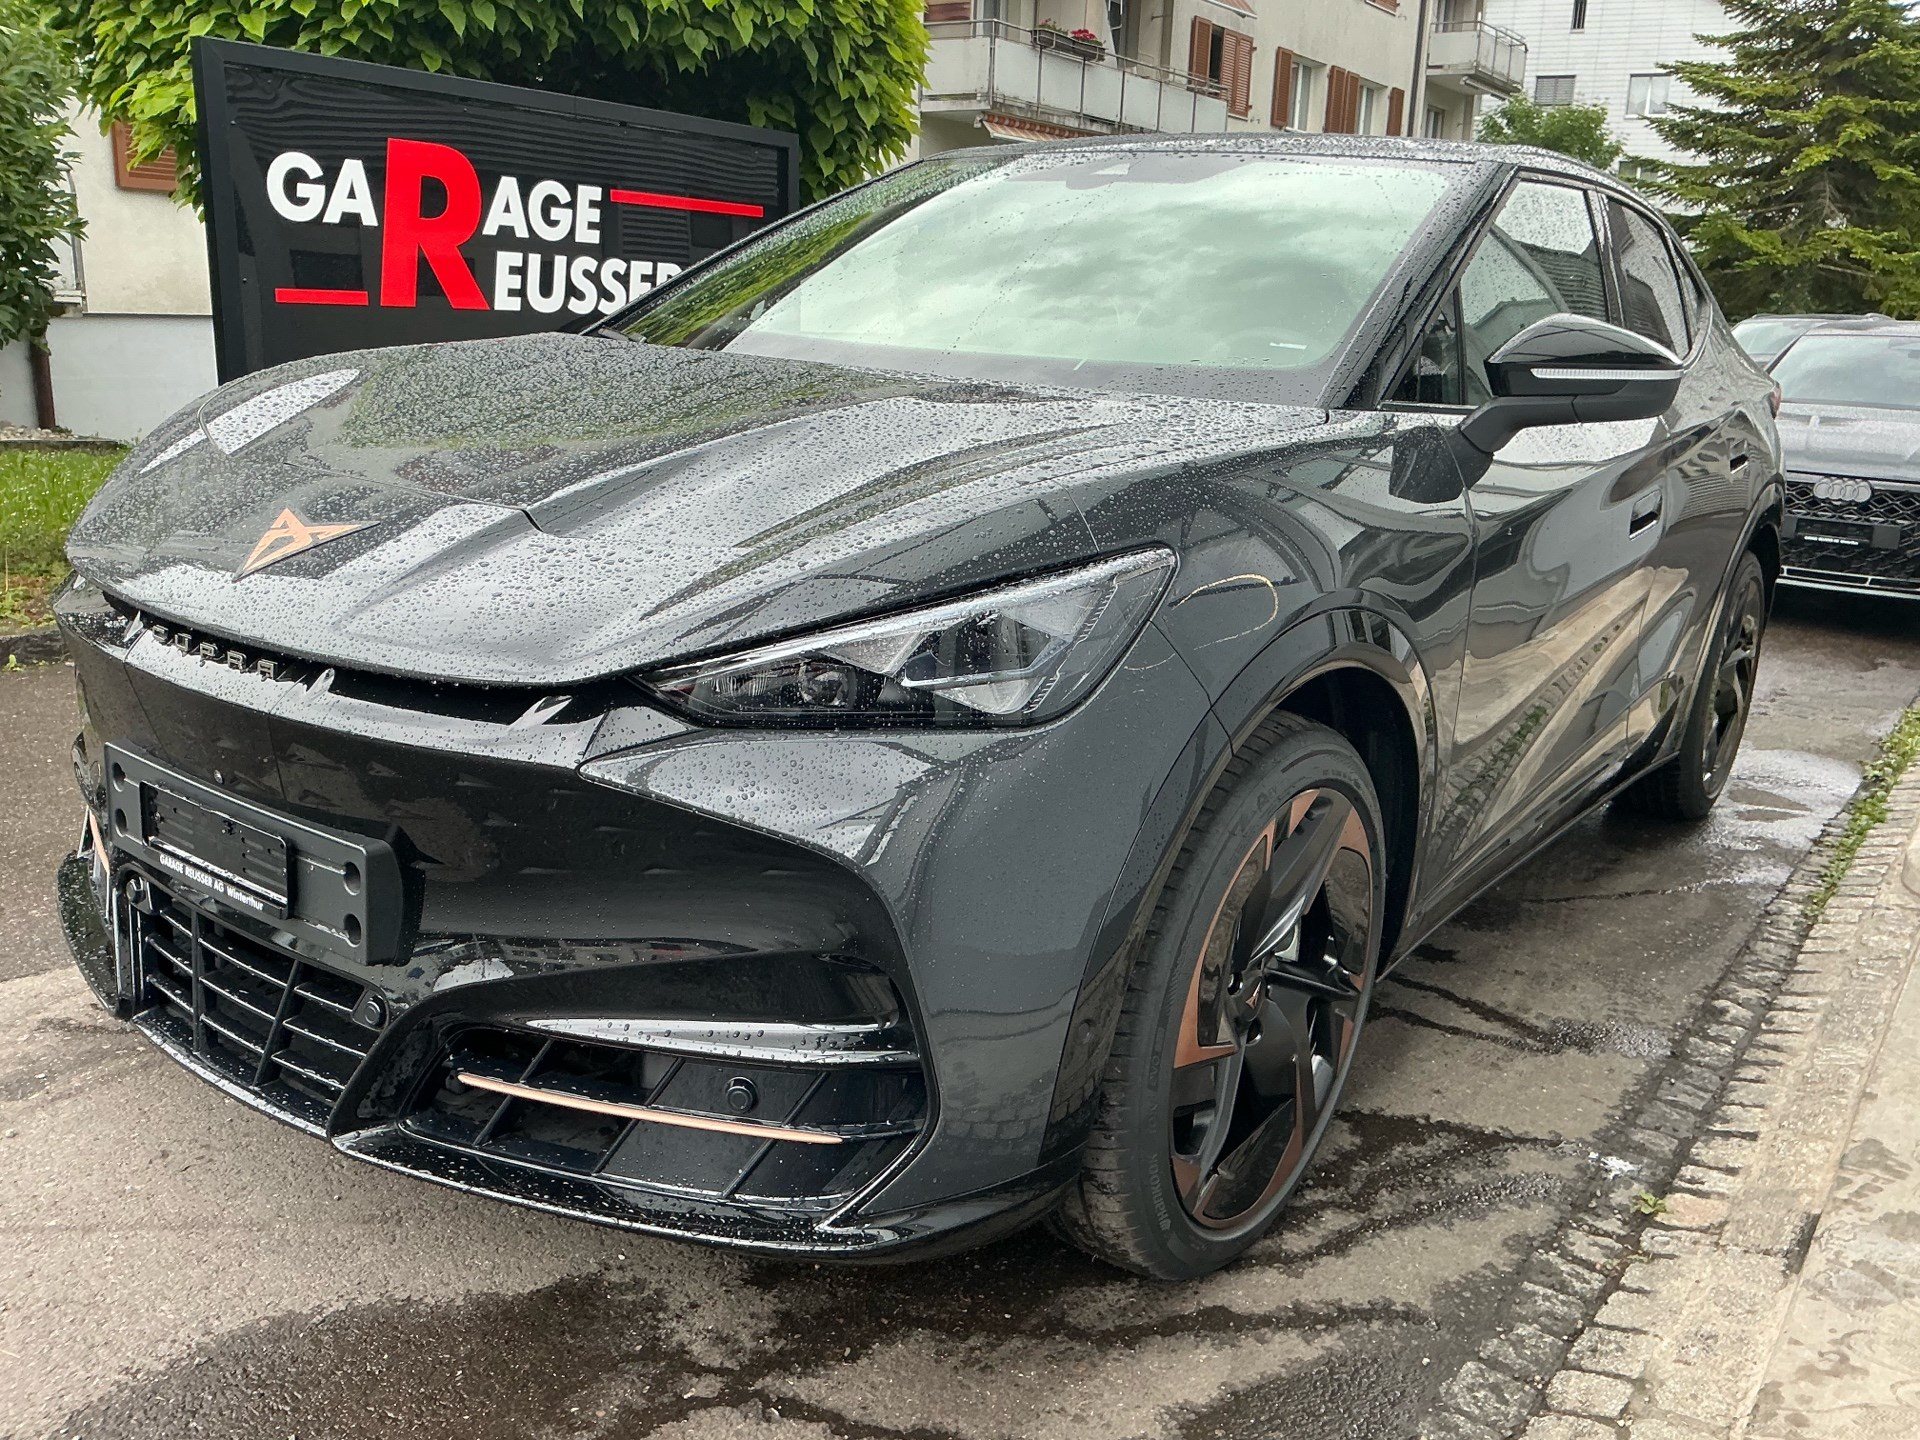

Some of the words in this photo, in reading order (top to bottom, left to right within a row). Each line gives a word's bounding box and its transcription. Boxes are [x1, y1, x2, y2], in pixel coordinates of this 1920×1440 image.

[266, 138, 602, 311] GARAGE
[152, 624, 277, 681] CUPRA
[159, 853, 184, 874] GARAGE
[184, 863, 213, 889] REUSSER
[213, 879, 225, 893] AG
[226, 885, 264, 911] Winterthur
